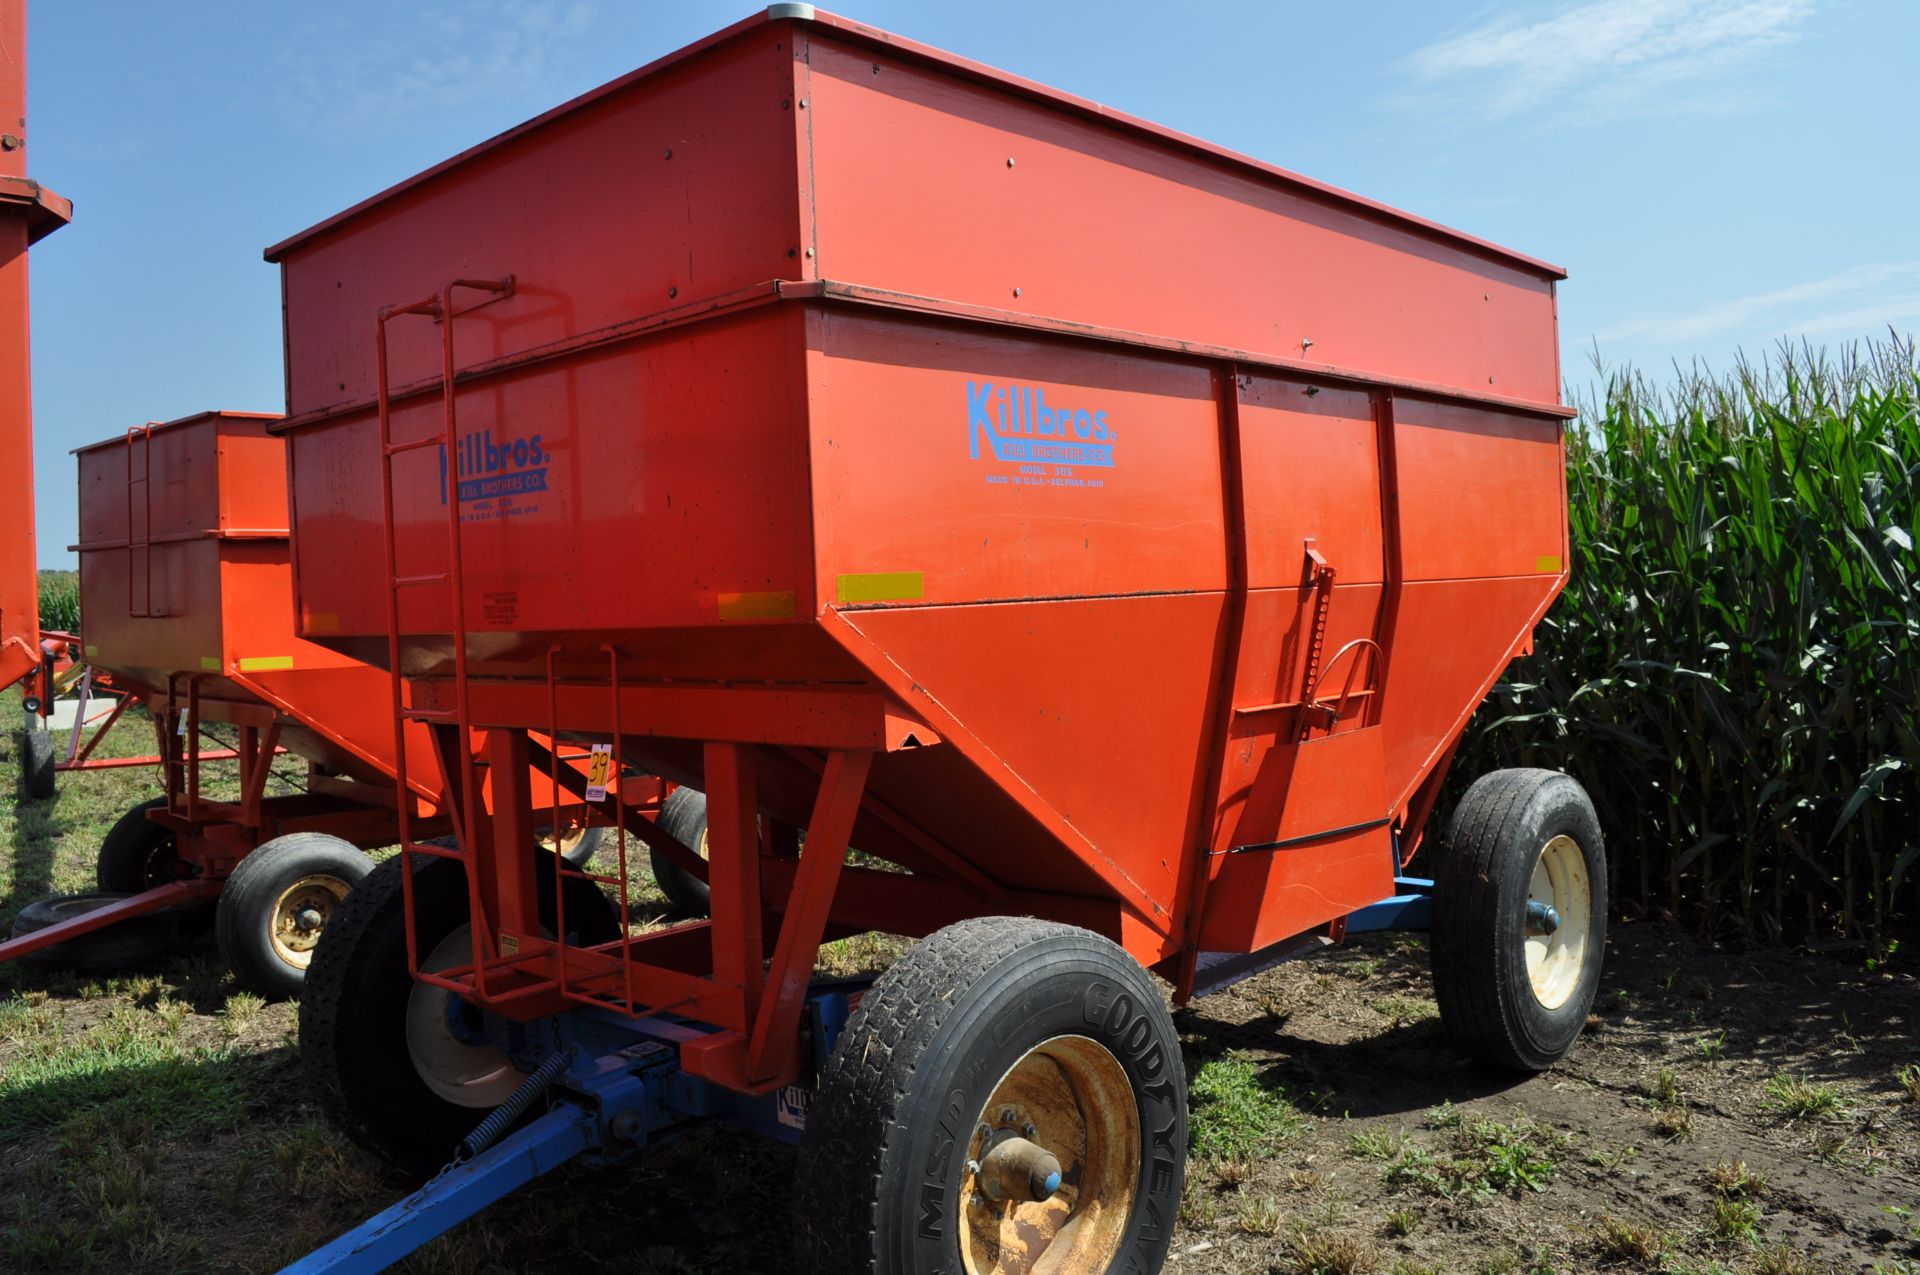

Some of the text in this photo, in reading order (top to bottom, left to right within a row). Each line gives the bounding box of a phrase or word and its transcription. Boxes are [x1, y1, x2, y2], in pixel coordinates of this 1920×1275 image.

[966, 380, 1117, 460] Killbros.
[1003, 444, 1026, 458] KILL
[1032, 445, 1085, 461] BROTHERS
[1019, 465, 1047, 475] MODEL
[482, 478, 522, 494] BROTHERS
[986, 475, 1008, 485] MADE
[589, 752, 608, 785] 39
